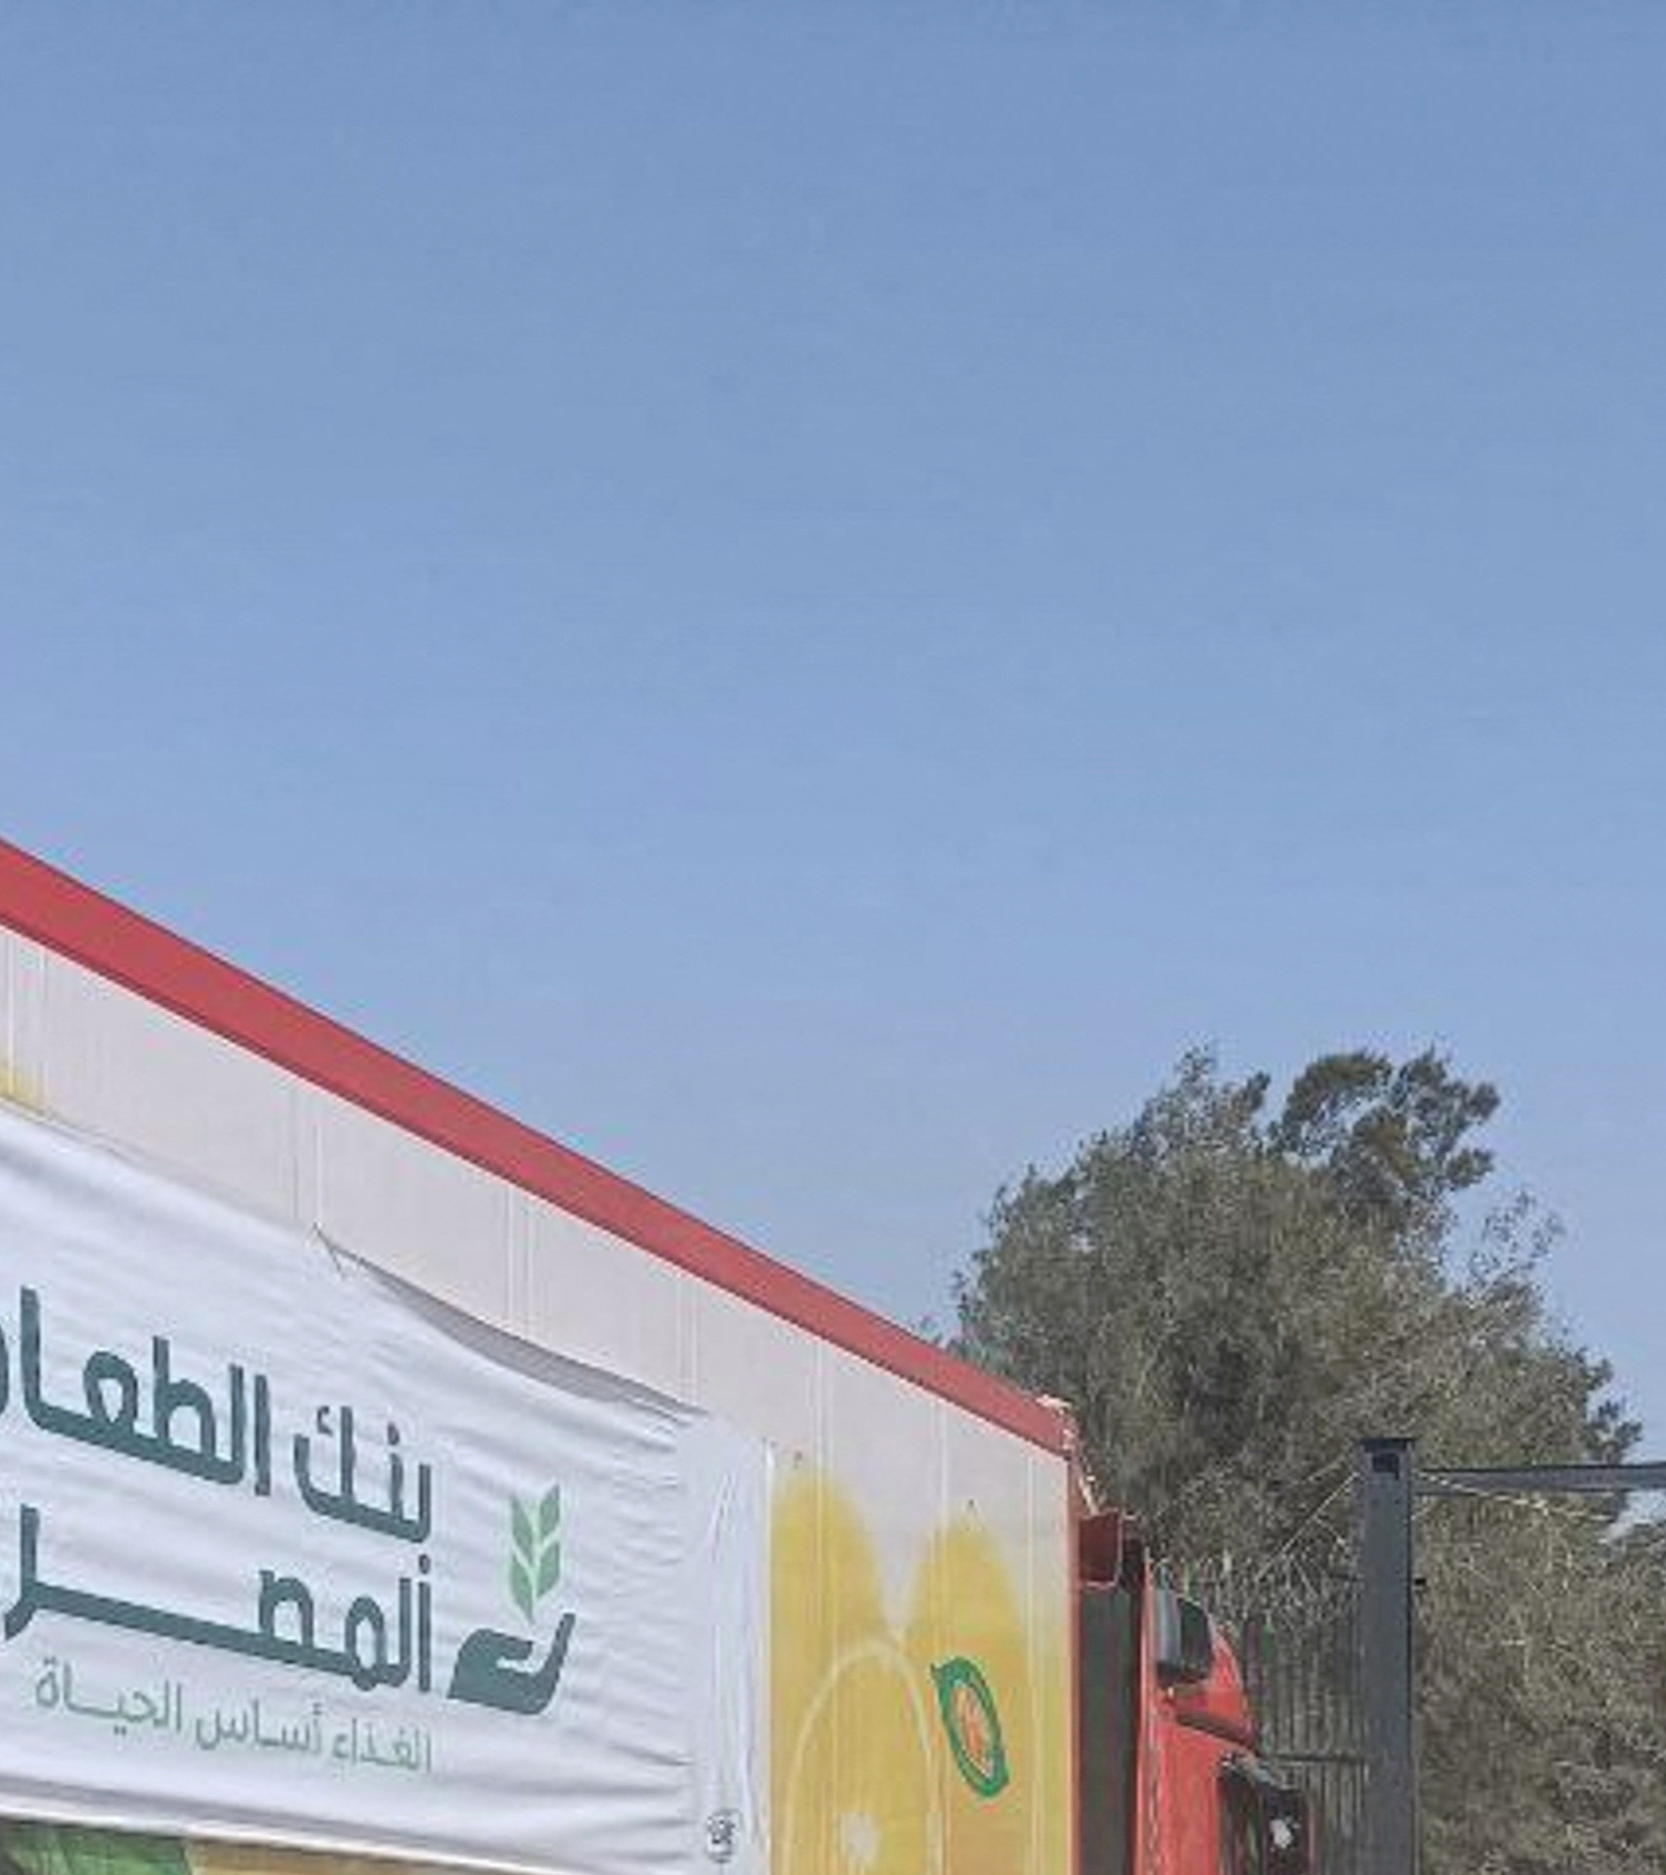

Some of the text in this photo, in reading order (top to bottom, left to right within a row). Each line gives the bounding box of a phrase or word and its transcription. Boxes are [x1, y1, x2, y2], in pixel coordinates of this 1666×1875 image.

[293, 1403, 432, 1573] بنك
[33, 1655, 183, 1735] الحياة
[196, 1701, 322, 1754] أساس
